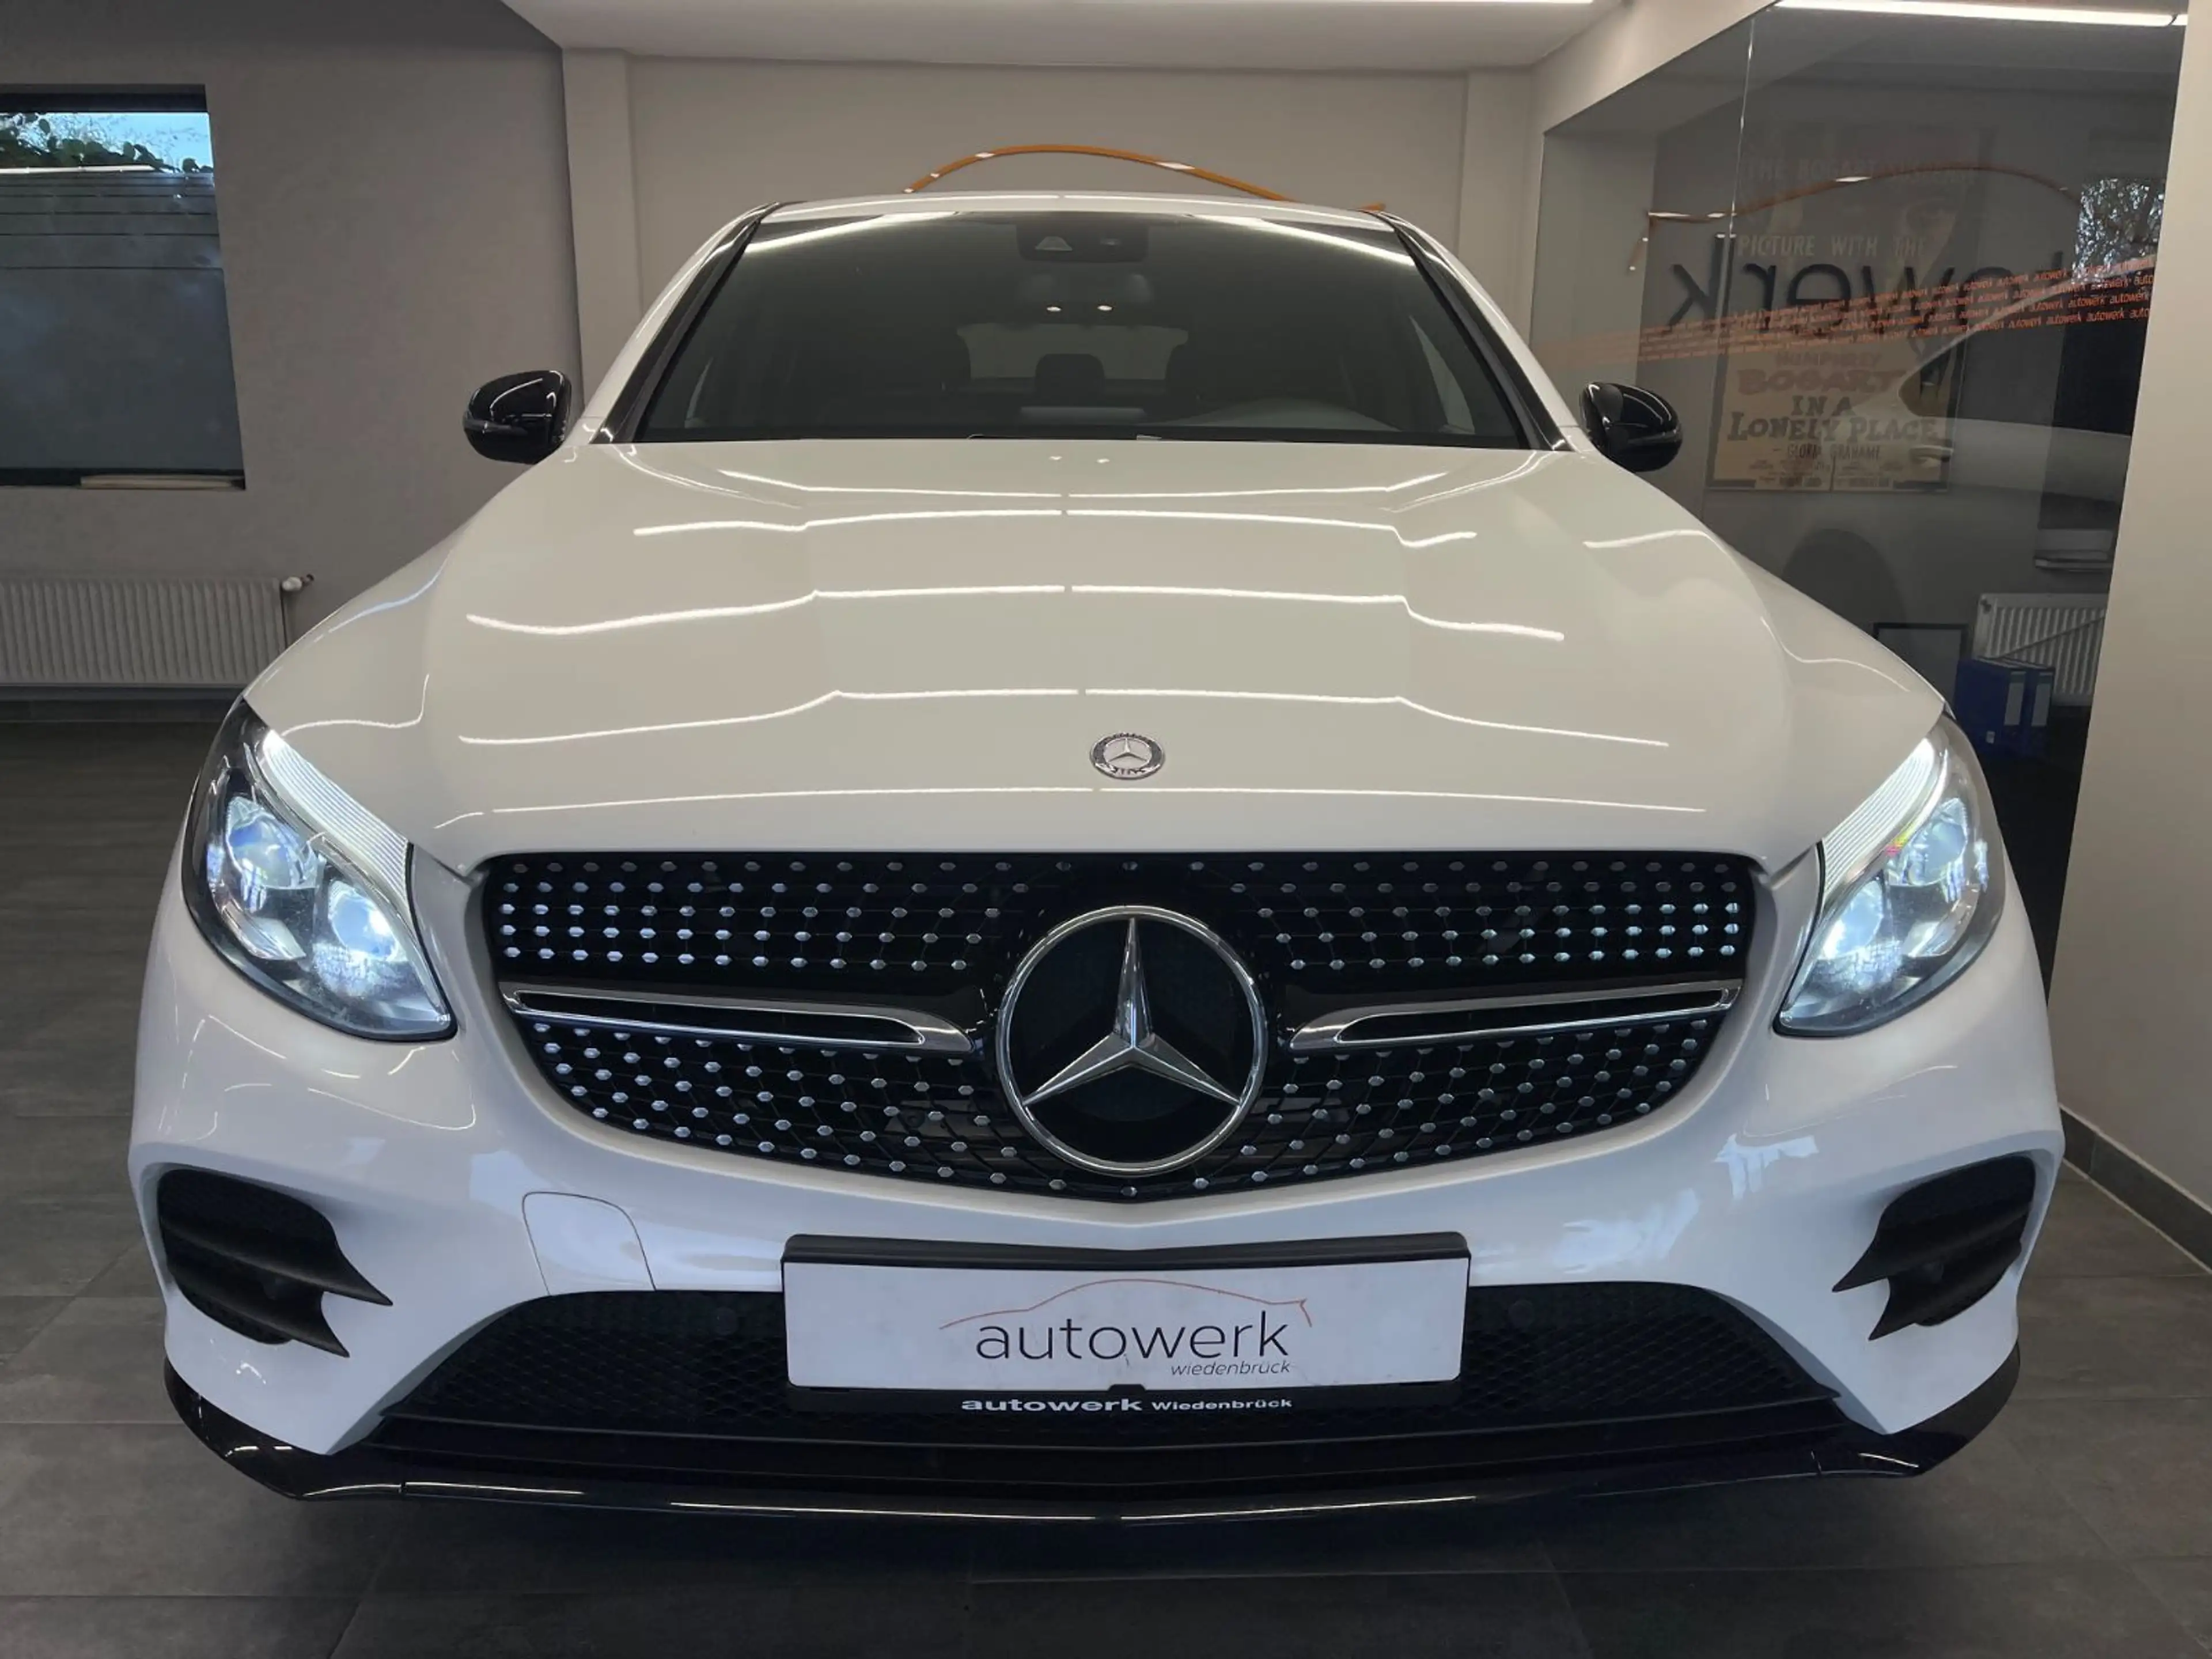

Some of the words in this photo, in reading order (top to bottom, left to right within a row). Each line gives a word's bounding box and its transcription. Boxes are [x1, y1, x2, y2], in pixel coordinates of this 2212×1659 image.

[1737, 235, 1816, 257] PICTURE
[1831, 234, 1878, 257] WITH
[1737, 369, 1908, 395] BOGART
[1790, 395, 1828, 416] IN
[1831, 396, 1856, 416] A
[1728, 411, 1839, 442] LONELY
[1846, 418, 1940, 442] PLACE
[976, 1310, 1289, 1360] autowerk
[961, 1398, 1143, 1411] autowerk
[1152, 1399, 1293, 1411] Wiedenbrück
